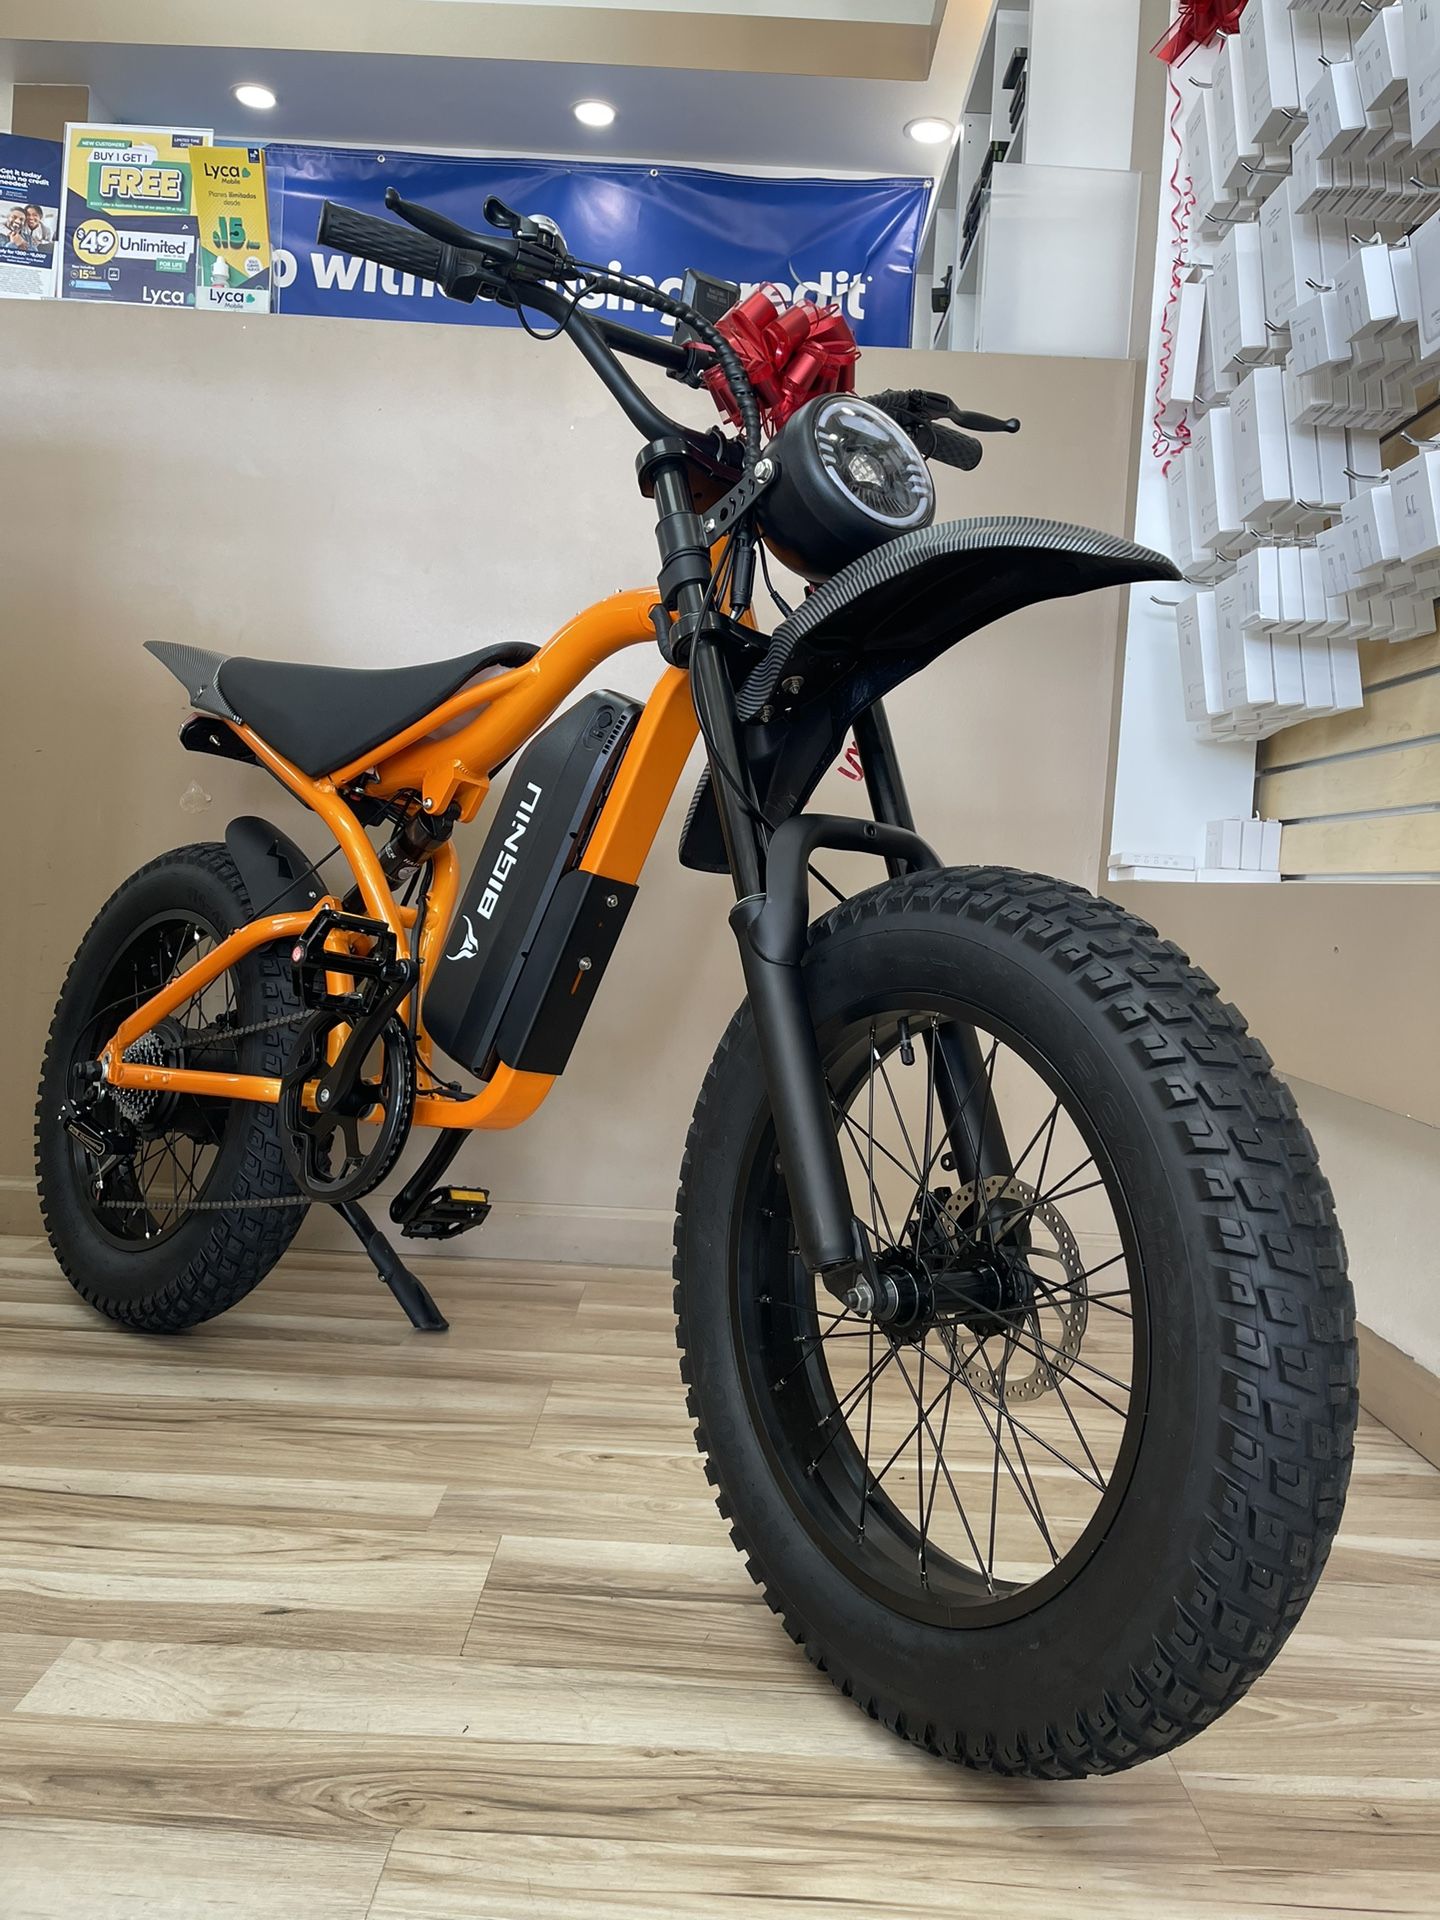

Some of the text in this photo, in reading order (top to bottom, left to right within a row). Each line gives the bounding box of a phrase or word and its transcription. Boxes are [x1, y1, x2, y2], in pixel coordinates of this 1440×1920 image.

[94, 151, 114, 161] BUY
[122, 153, 143, 162] GET
[204, 163, 240, 179] Lyca
[101, 166, 181, 201] FREE
[77, 228, 115, 255] $49
[120, 236, 186, 255] Unlimited
[79, 269, 89, 280] 15
[143, 286, 185, 305] Lyca
[209, 288, 244, 304] Lyca
[476, 781, 543, 920] BIGNIU
